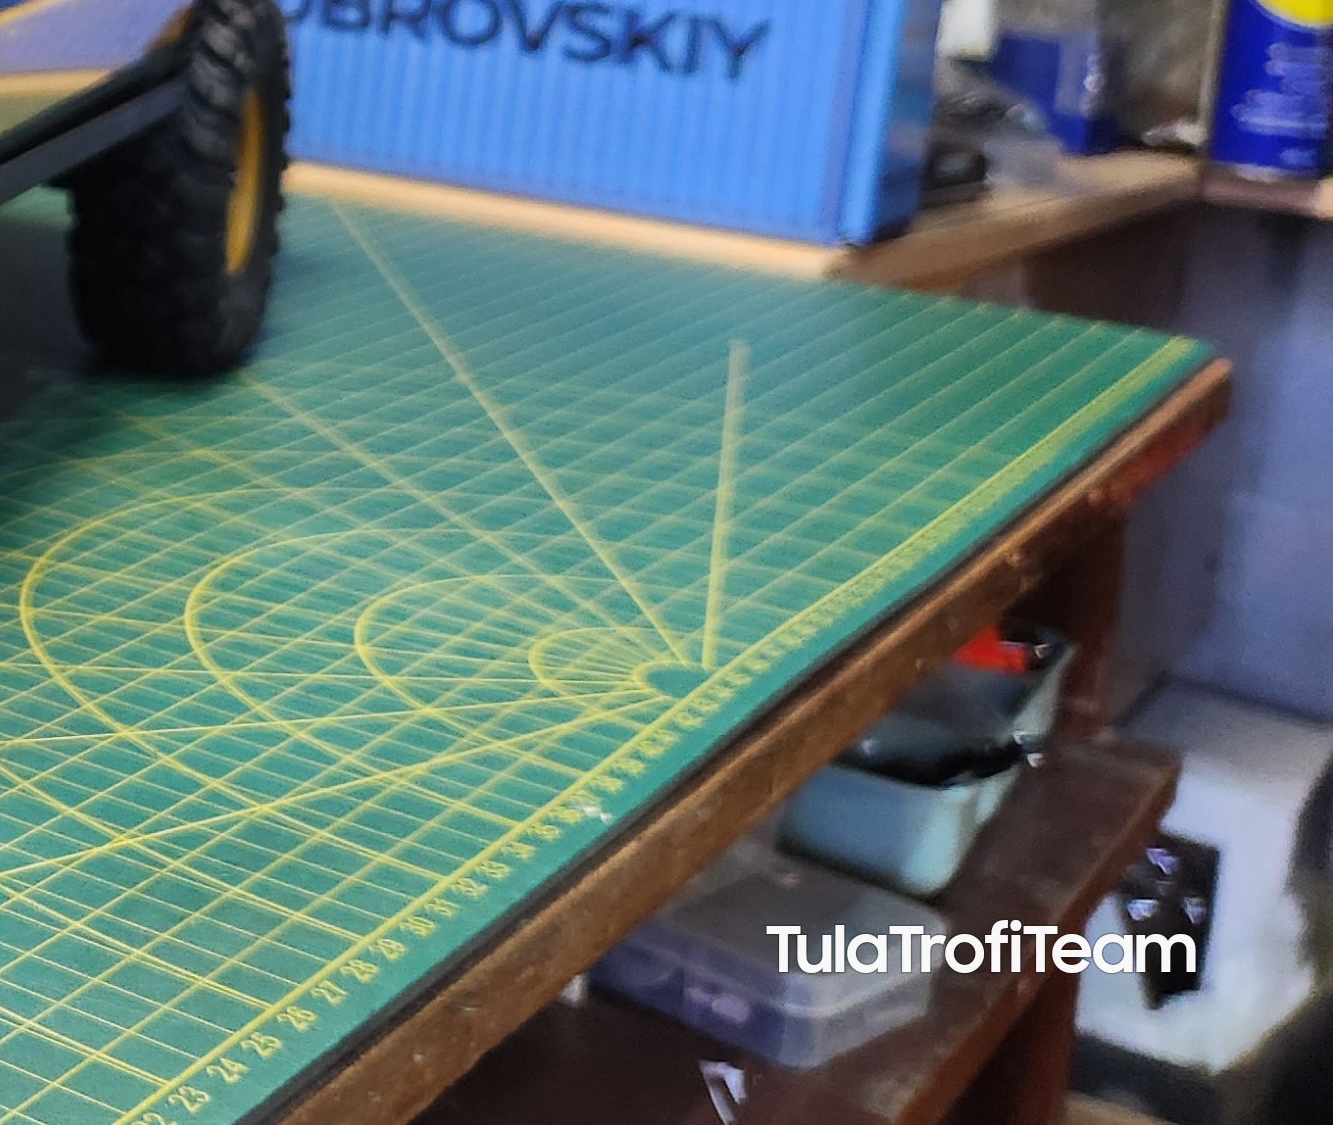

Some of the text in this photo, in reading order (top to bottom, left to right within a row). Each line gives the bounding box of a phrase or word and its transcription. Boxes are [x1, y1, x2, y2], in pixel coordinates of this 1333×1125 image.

[276, 1006, 318, 1032] 26
[240, 1031, 283, 1059] 25
[206, 1057, 249, 1084] 24
[168, 1085, 211, 1113] 23
